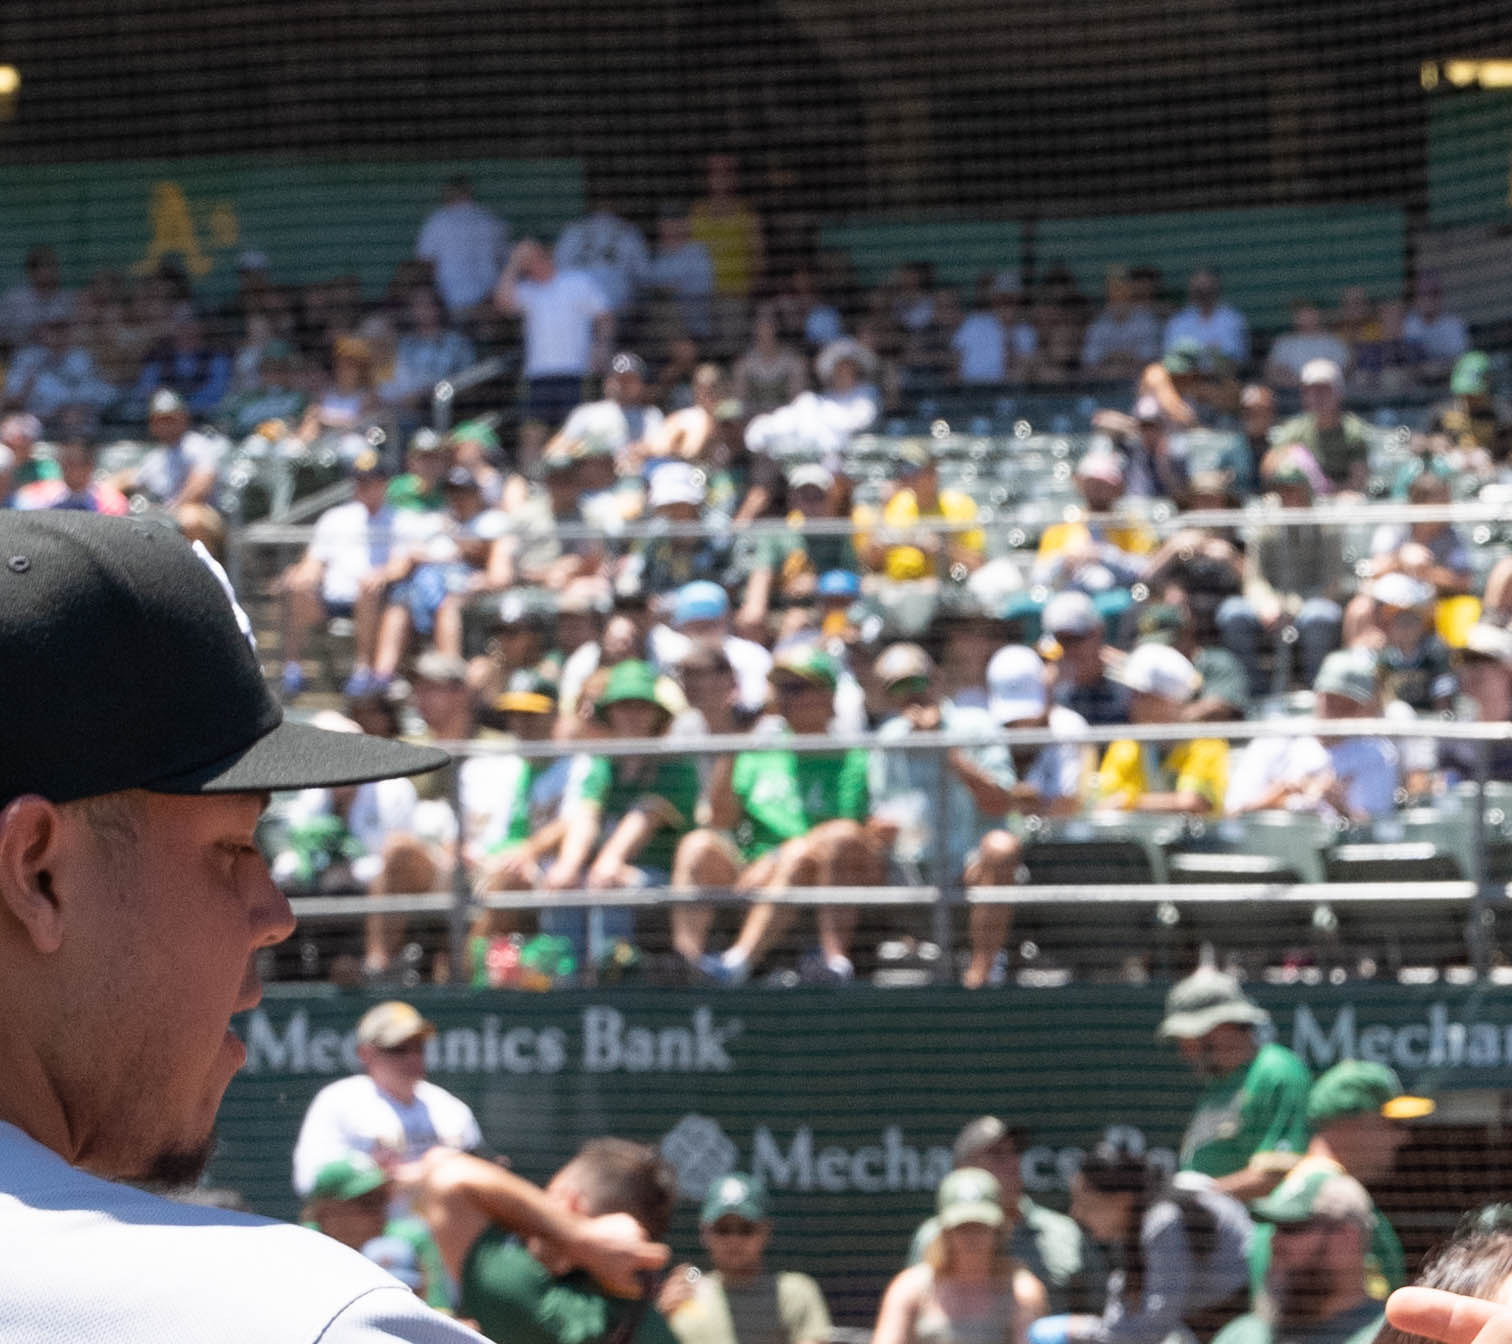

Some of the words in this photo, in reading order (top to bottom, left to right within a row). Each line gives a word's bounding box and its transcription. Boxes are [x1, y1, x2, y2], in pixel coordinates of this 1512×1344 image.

[246, 1006, 569, 1074] Mecnics
[582, 1004, 736, 1073] Bank
[750, 1123, 1086, 1193] Mechacs
